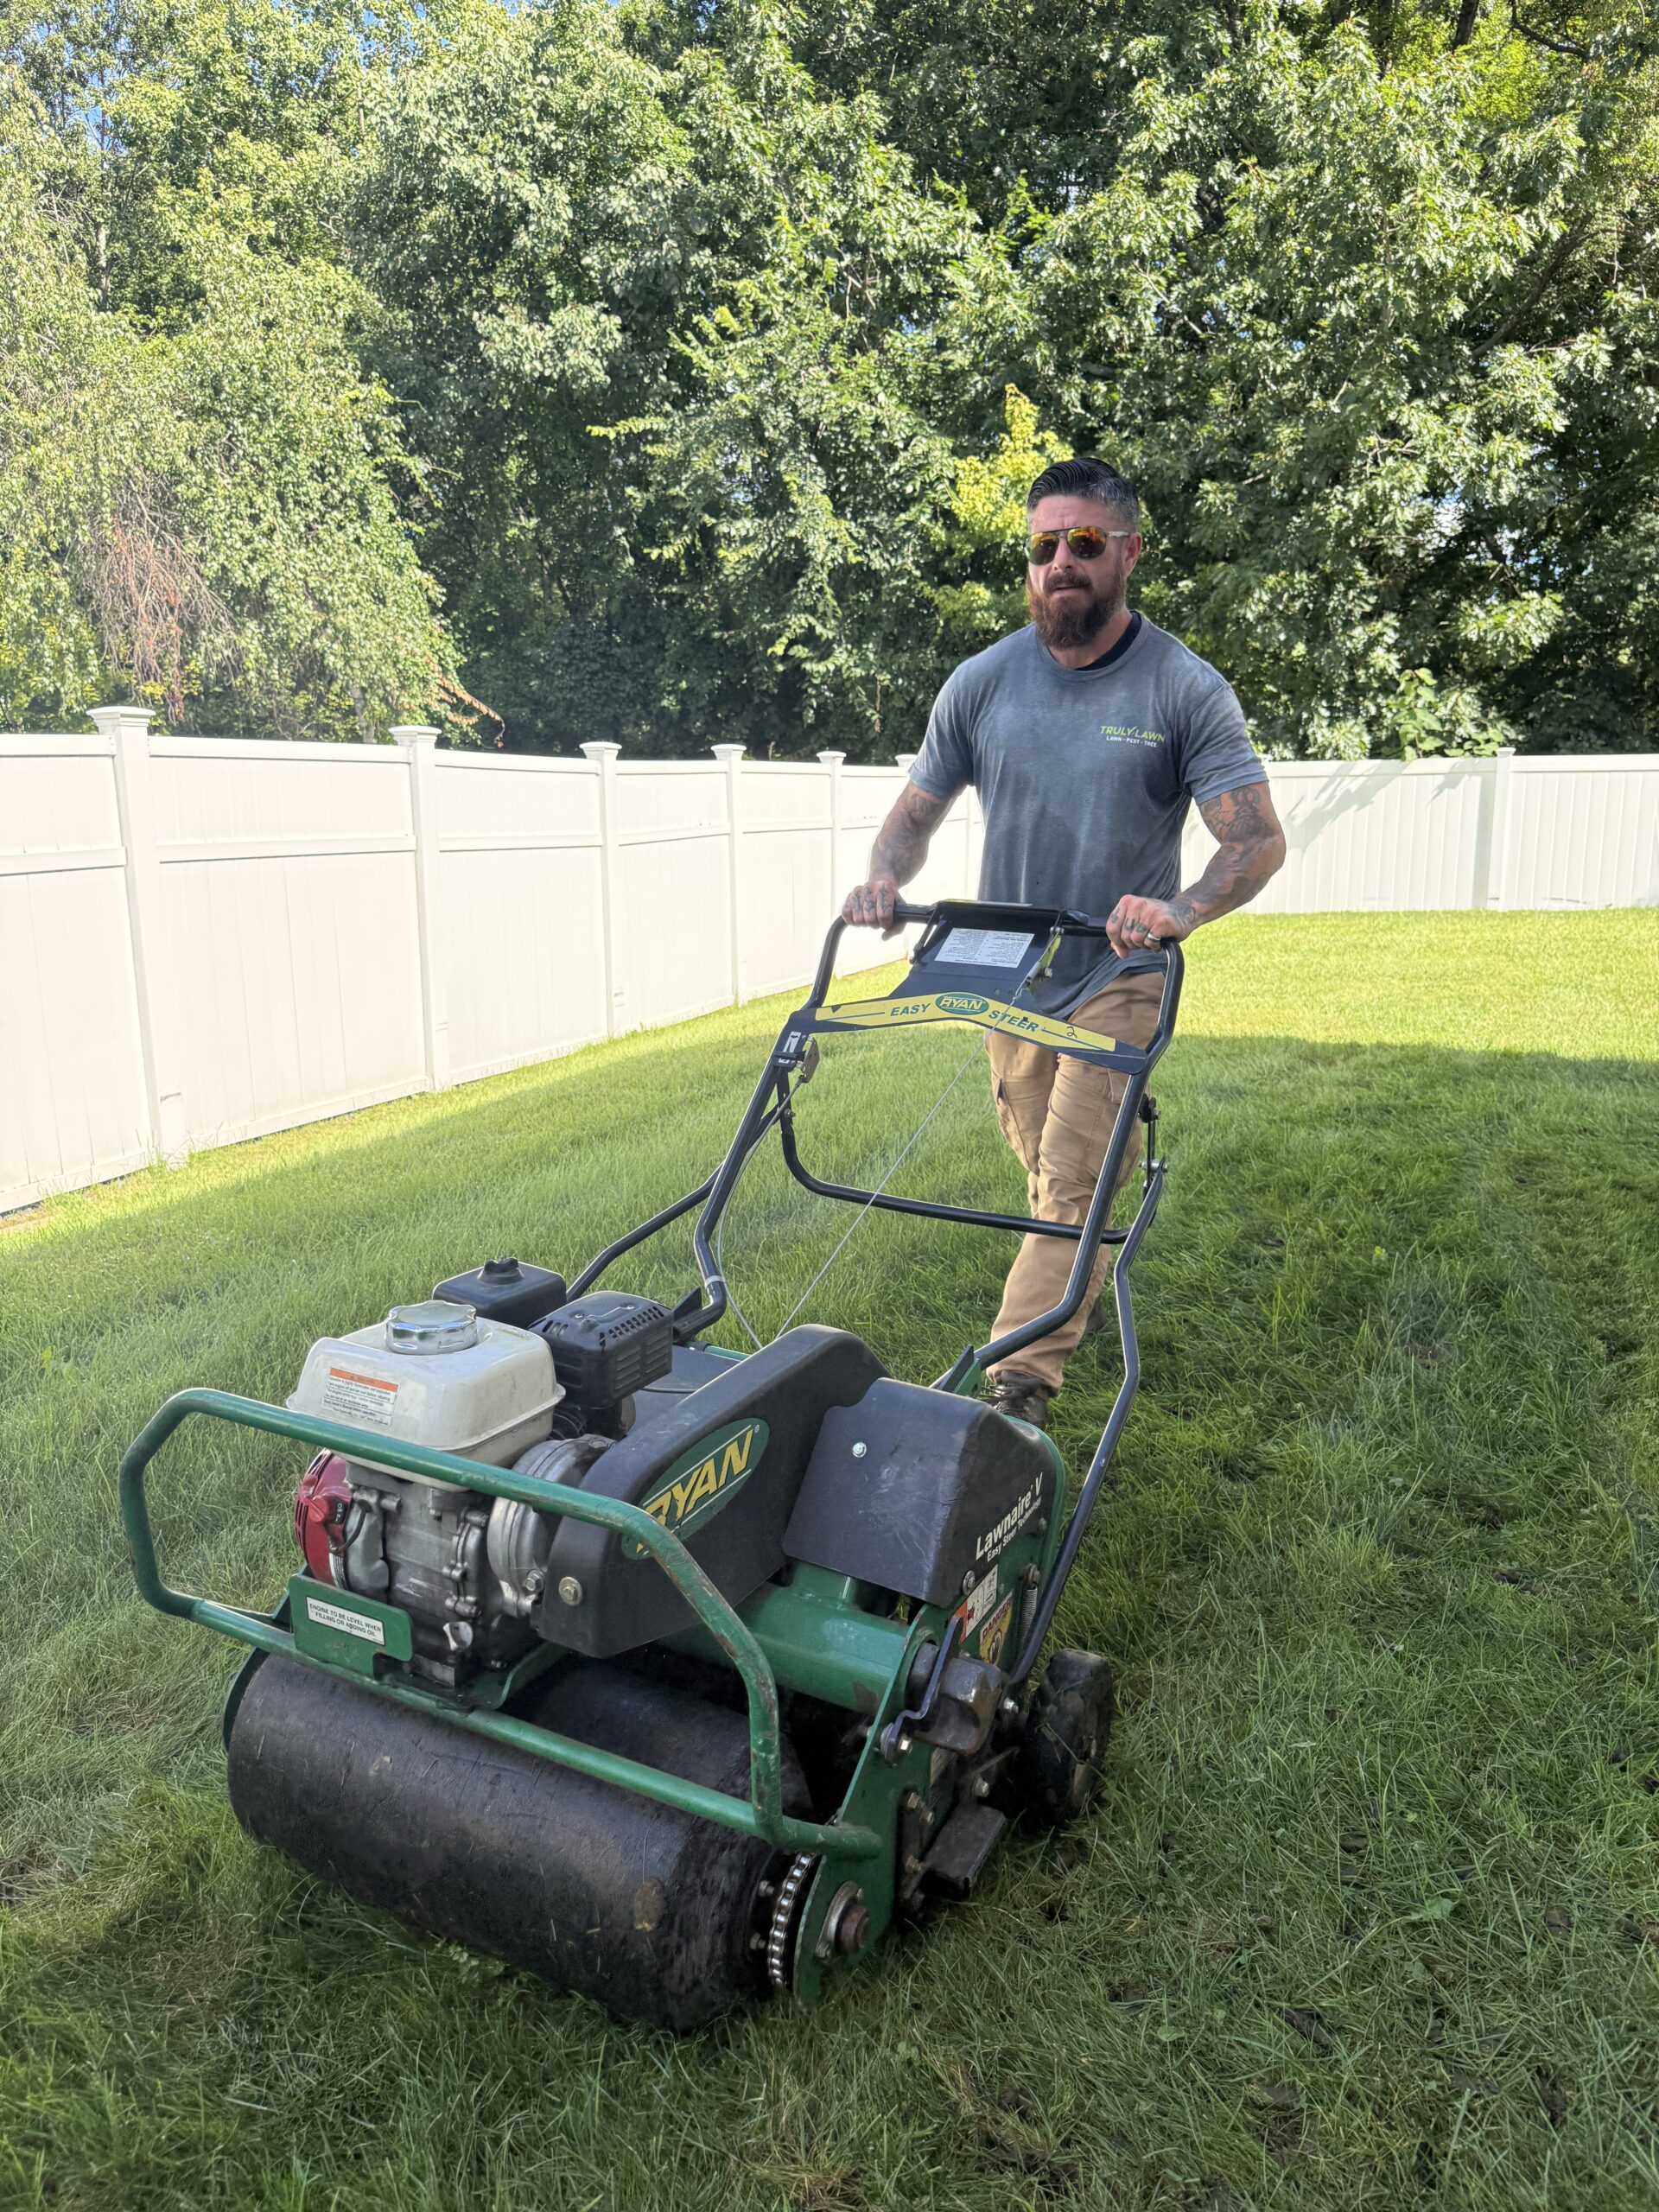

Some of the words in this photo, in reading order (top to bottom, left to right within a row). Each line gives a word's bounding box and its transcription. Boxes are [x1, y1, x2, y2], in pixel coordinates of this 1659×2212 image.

[1100, 726, 1137, 735] TRULY
[1135, 729, 1166, 742] LAWN
[890, 1003, 931, 1016] EASY
[940, 997, 982, 1010] RYAN
[988, 1010, 1039, 1032] STEER
[1066, 1026, 1077, 1039] 2
[637, 1429, 754, 1553] RYAN
[976, 1491, 1032, 1560] Lawnaire
[1035, 1471, 1043, 1497] V
[987, 1542, 1002, 1562] Easy
[1002, 1526, 1017, 1547] Steer
[309, 1604, 328, 1614] ENGINE
[346, 1616, 363, 1625] LEVEL
[364, 1622, 381, 1631] WHEN
[315, 1611, 335, 1623] FILLING
[346, 1622, 365, 1633] ADDING
[982, 1597, 1011, 1639] DANGER
